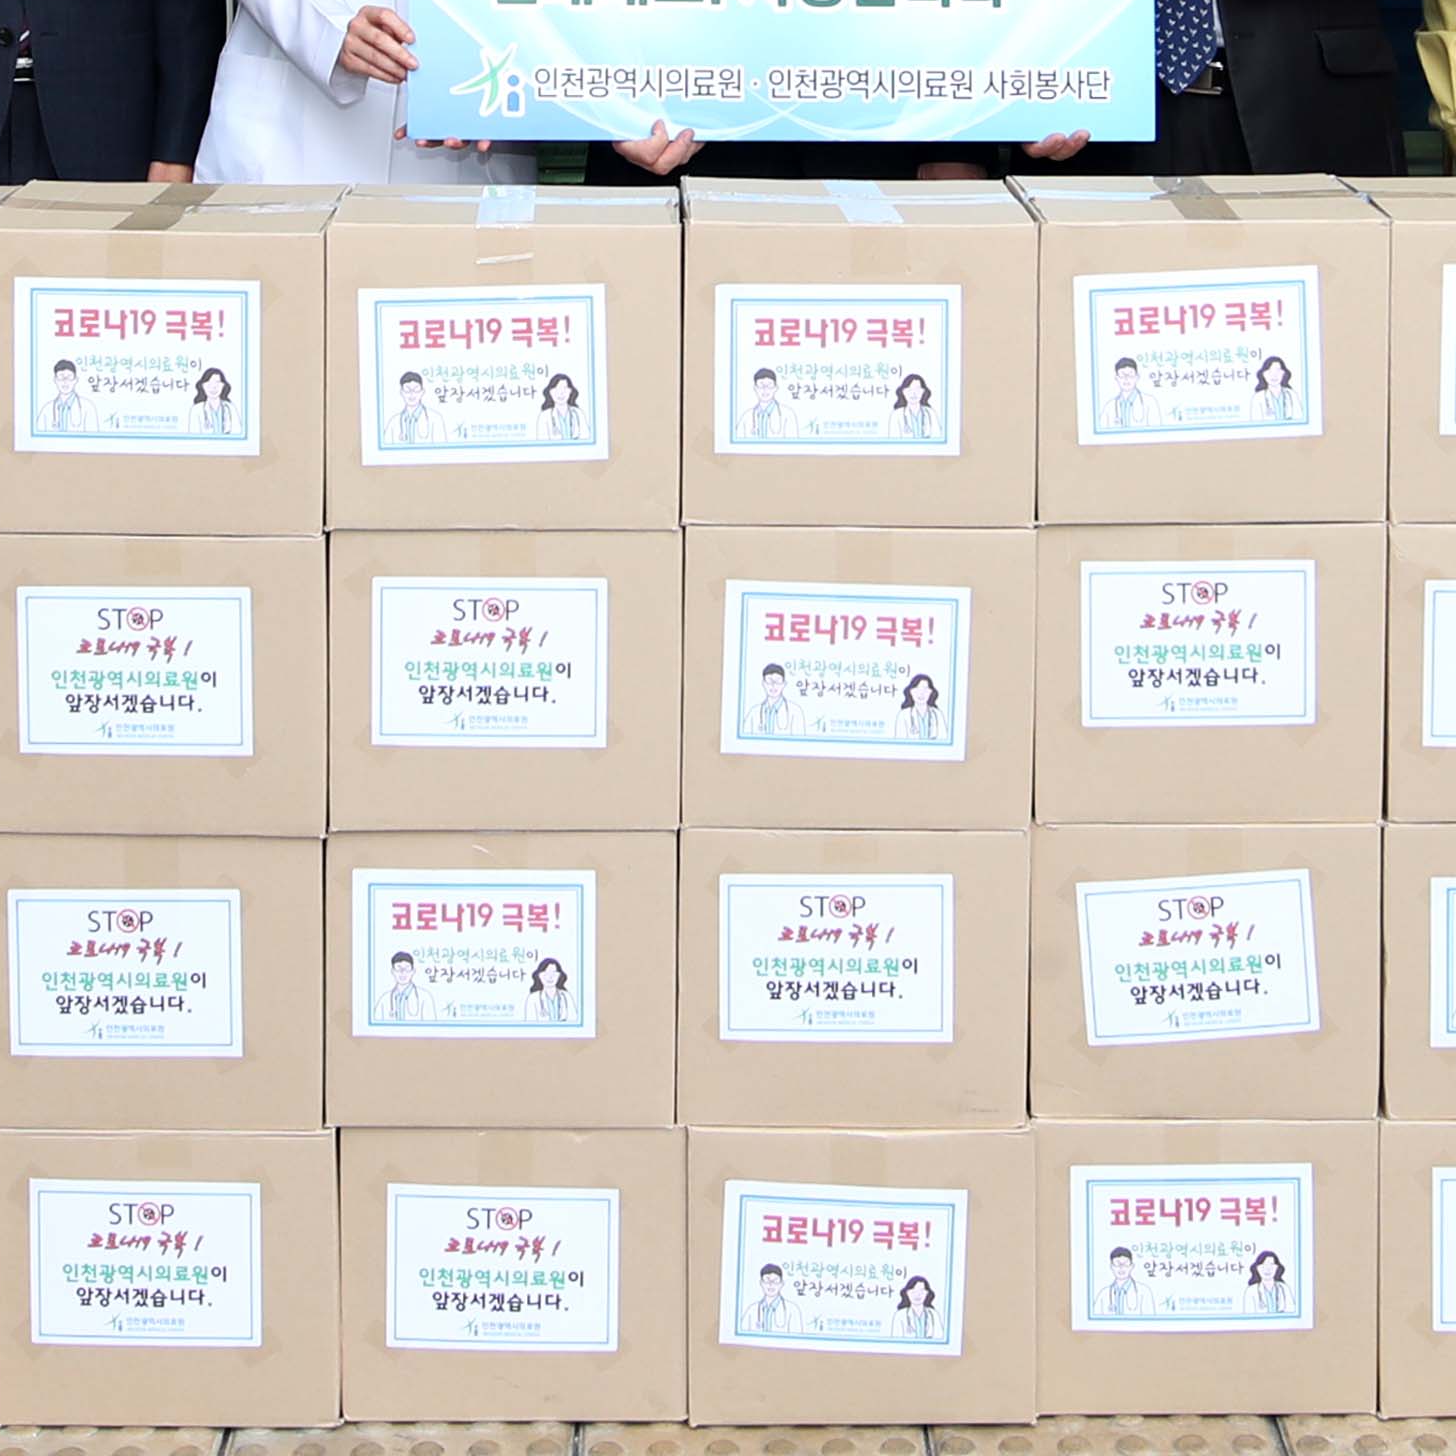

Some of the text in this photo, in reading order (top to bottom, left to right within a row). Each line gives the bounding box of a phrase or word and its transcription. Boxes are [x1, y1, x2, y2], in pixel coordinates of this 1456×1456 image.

[534, 66, 1111, 102] 인천광역시의료원 인천광역시의료원 사회봉사단
[54, 308, 225, 341] 코로나19 극복!
[1113, 299, 1284, 338] 코로나19 극복!
[398, 315, 571, 351] 코로나19 극복!
[755, 317, 926, 348] 코로나19 극복!
[764, 612, 935, 648] 코로나19 극복!
[1114, 643, 1281, 664] 인천광역시의료원이
[50, 669, 216, 691] 인천광역시의료원이
[404, 660, 571, 682] 인천광역시의료원이
[1128, 667, 1266, 688] 앞장서겠습니다.
[65, 693, 202, 714] 앞장서겠습니다.
[418, 685, 556, 706] 앞장서겠습니다.
[392, 902, 561, 932] 코로나19 극복!
[752, 956, 918, 978] 인천광역시의료원이
[1114, 953, 1281, 983] 인천광역시의료원이
[42, 971, 206, 992] 인천광역시의료원이
[766, 980, 903, 1001] 앞장서겠습니다.
[1130, 977, 1268, 1006] 앞장서겠습니다.
[56, 995, 192, 1015] 앞장서겠습니다.
[1111, 1196, 1278, 1227] 코로나19 극복!
[762, 1215, 932, 1251] 코로나19 극복!
[61, 1262, 226, 1286] 인천광역시의료원이
[418, 1267, 584, 1291] 인천광역시의료원이
[76, 1287, 212, 1309] 앞장서겠습니다.
[432, 1291, 569, 1313] 앞장서겠습니다.
